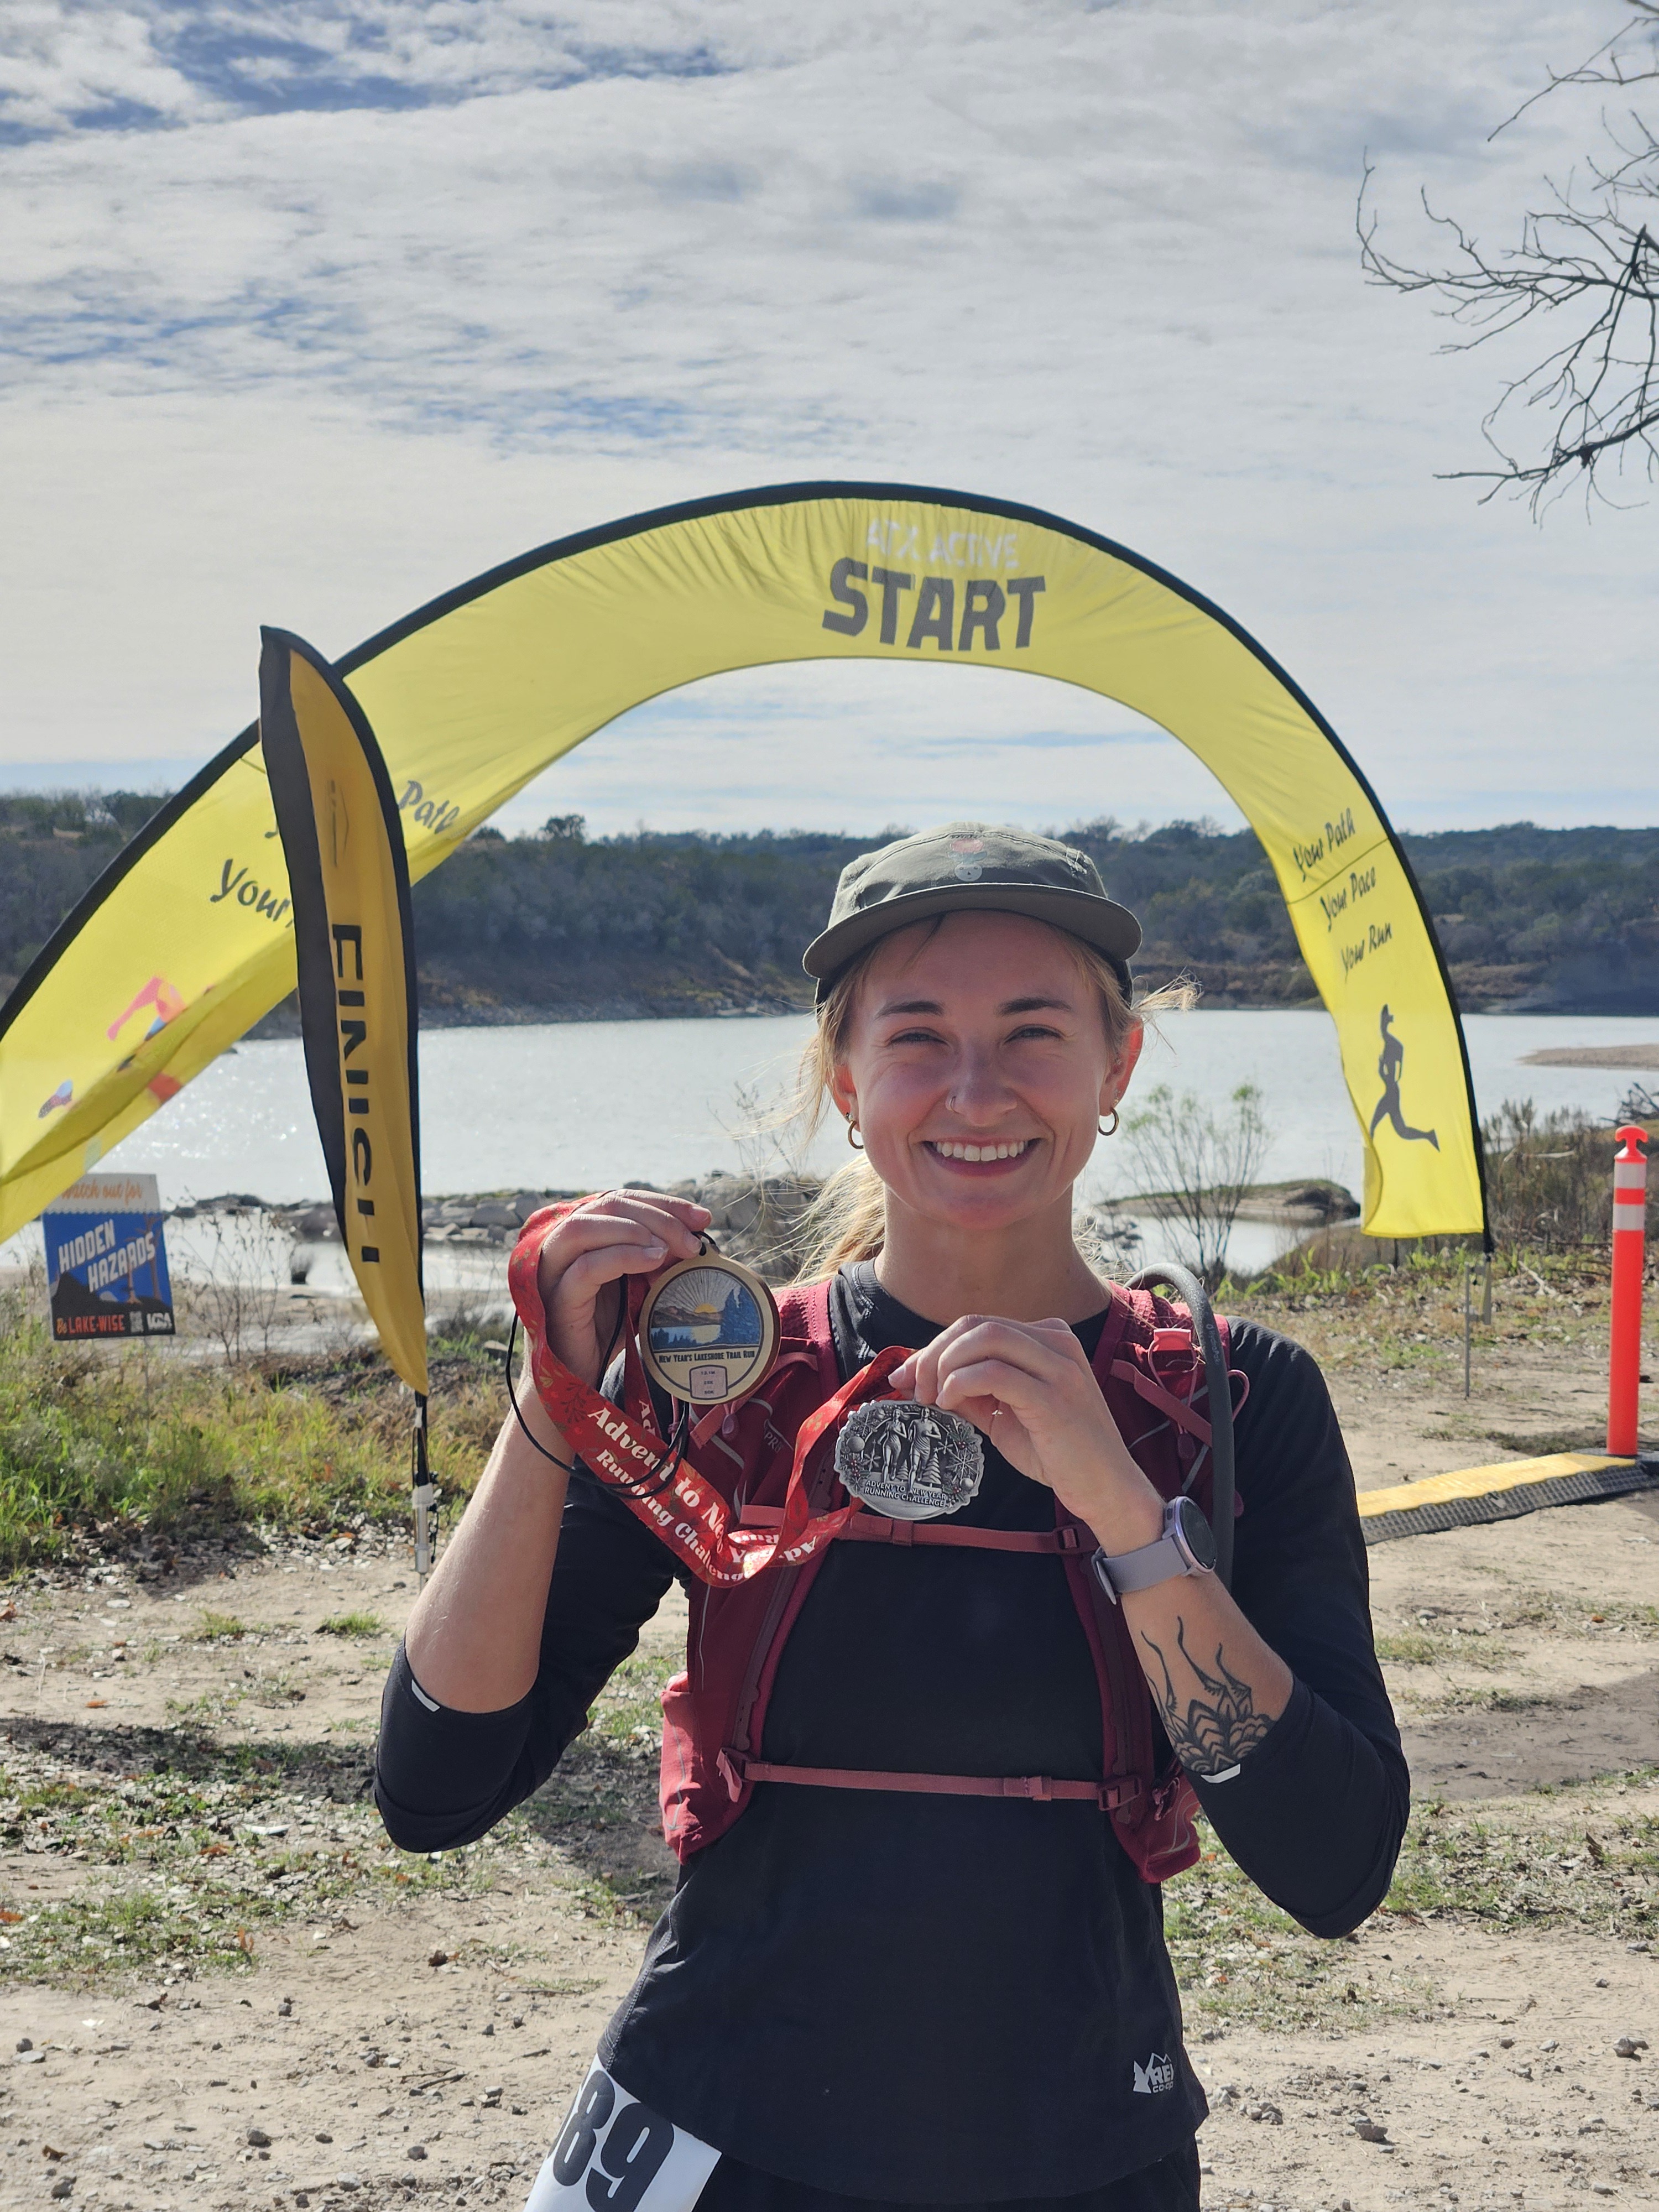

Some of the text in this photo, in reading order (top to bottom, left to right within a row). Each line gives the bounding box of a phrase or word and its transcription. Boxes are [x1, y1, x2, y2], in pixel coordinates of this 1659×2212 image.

[929, 531, 1020, 569] ACTIVE
[822, 556, 1046, 651] START
[1293, 807, 1355, 883] Your Path
[210, 858, 290, 922] Your
[1320, 867, 1376, 933] Your Pace
[1341, 922, 1392, 984] Your Run
[58, 1218, 116, 1275] HIDDEN
[87, 1231, 155, 1293] HAZARDS
[659, 1355, 671, 1363] NEW
[673, 1354, 692, 1363] YEAR'S
[694, 1352, 724, 1361] LAKESHORE
[726, 1351, 742, 1359] TRAIL
[587, 1407, 675, 1481] Advent
[675, 1477, 700, 1507] to
[596, 1449, 745, 1582] Running Challeng
[864, 1487, 945, 1507] RUNNING CHALLENGE
[865, 1480, 894, 1491] ADVENT
[912, 1488, 927, 1496] NEW
[927, 1490, 946, 1500] YEAR
[1150, 2063, 1174, 2085] REI
[553, 2069, 675, 2212] 89
